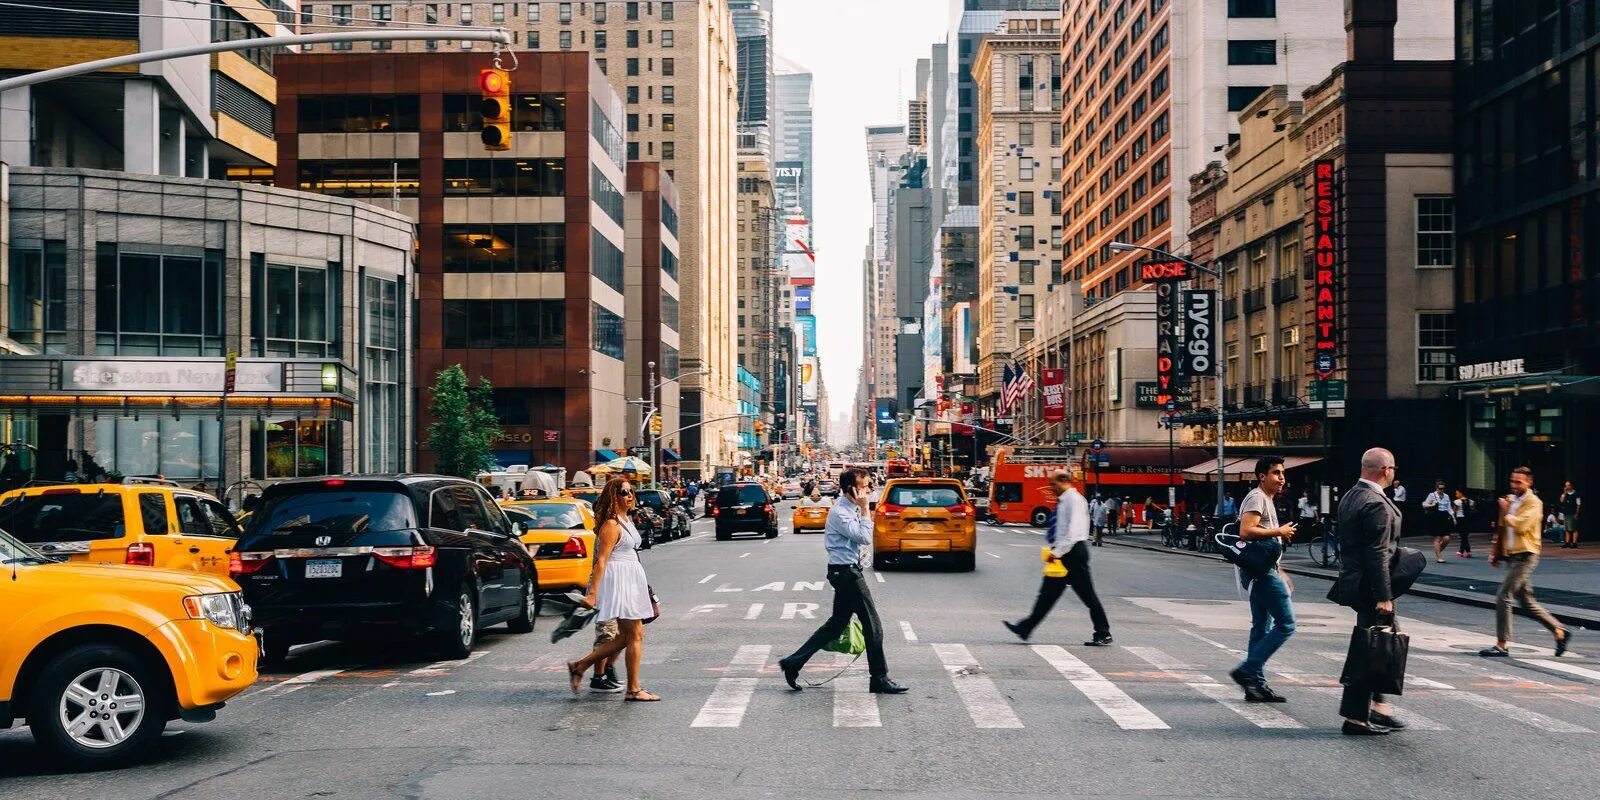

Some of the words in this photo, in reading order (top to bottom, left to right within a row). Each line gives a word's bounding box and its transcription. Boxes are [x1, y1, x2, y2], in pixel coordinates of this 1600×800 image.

[1317, 164, 1334, 337] RESTAURANT
[1142, 262, 1187, 279] ROSIE
[1188, 293, 1209, 372] nycgo
[73, 364, 170, 386] Sheraton
[1043, 384, 1064, 396] JERSEY
[1140, 386, 1159, 395] THE
[713, 581, 835, 592] LAN
[680, 603, 819, 620] FIR
